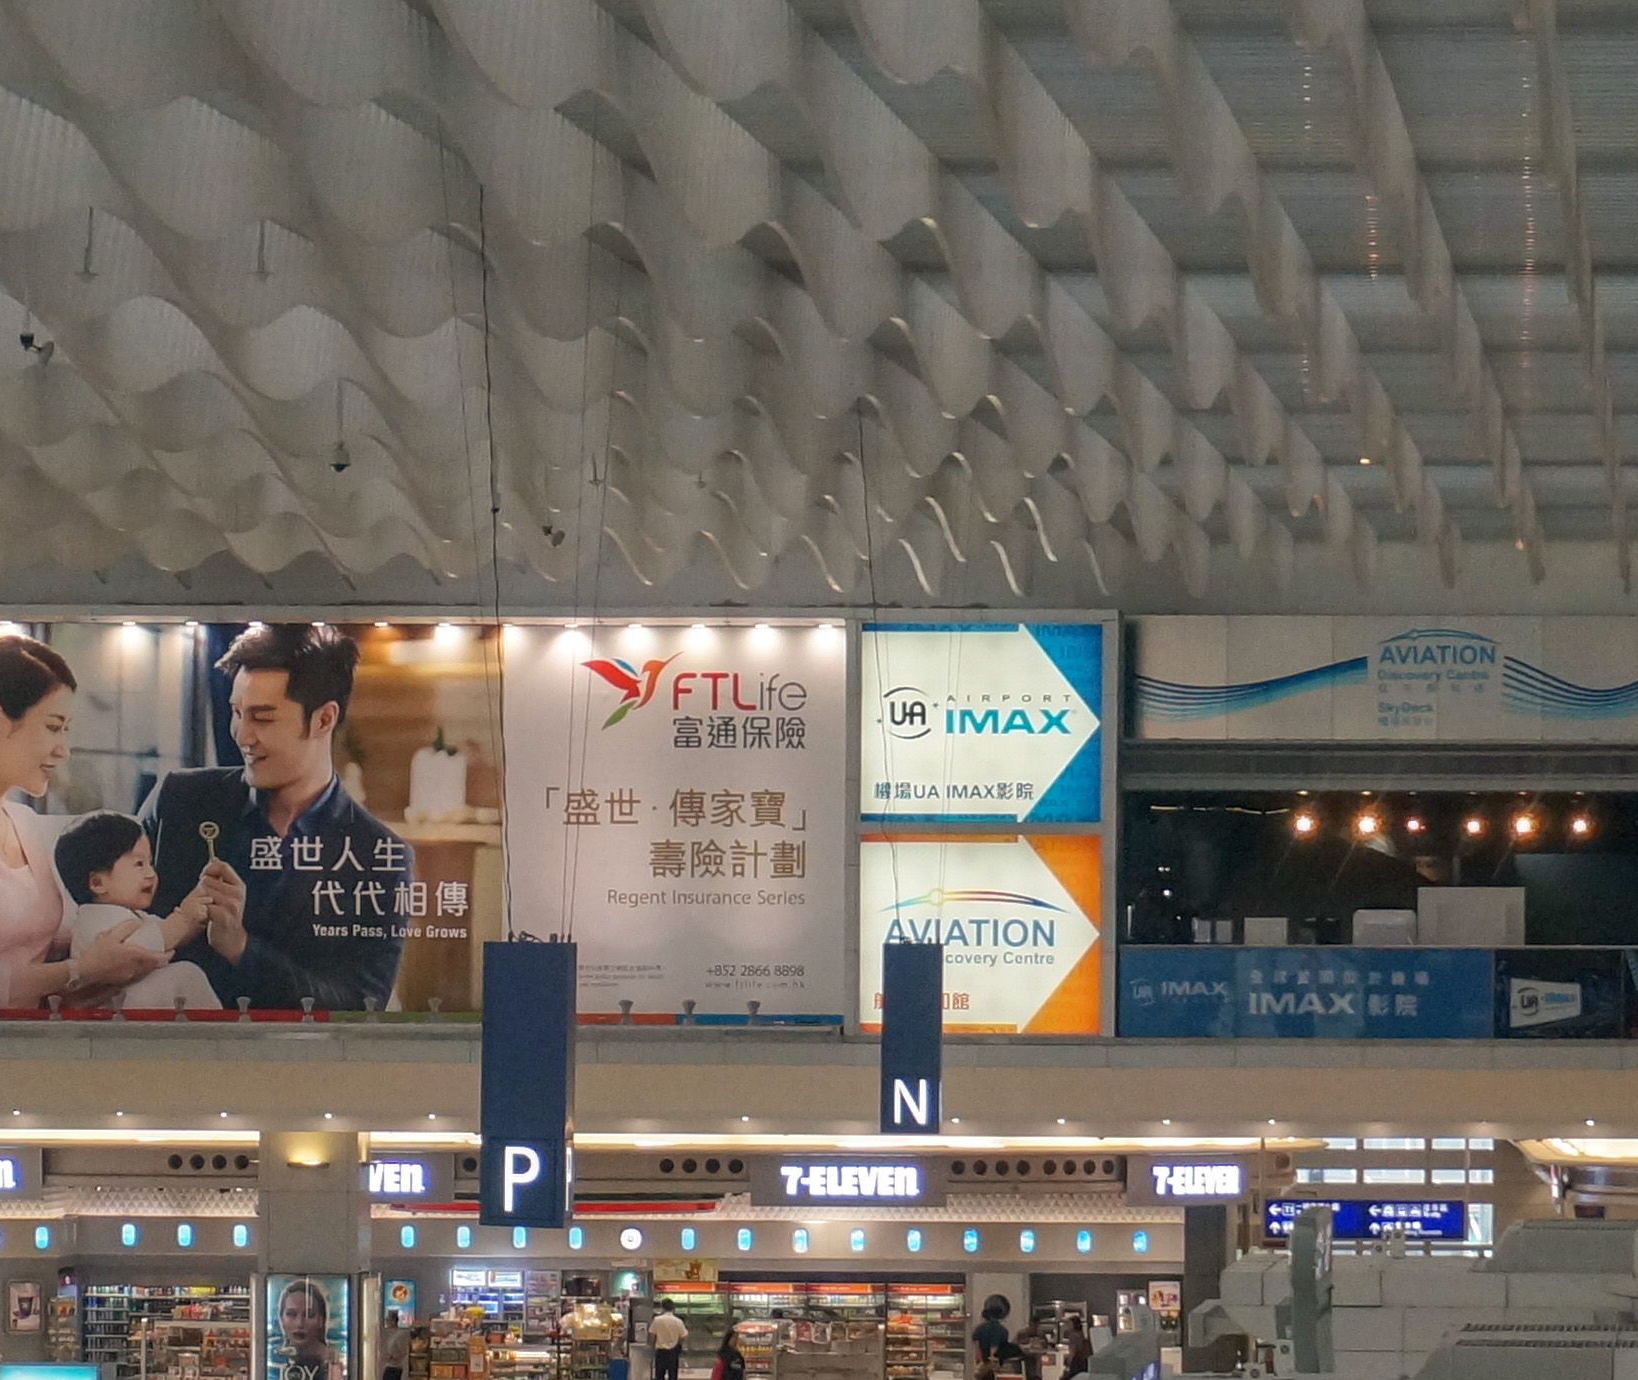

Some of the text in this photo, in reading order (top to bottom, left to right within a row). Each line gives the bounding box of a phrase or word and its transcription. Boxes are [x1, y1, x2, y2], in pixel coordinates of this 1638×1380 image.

[1379, 645, 1496, 665] AVIATION
[672, 673, 807, 711] FTLife
[947, 694, 1071, 703] AIRPORT
[889, 700, 926, 726] UA
[946, 709, 1071, 734] IMAX
[672, 716, 806, 749] 富通保險
[250, 835, 406, 871] 盛世人生
[650, 839, 805, 879] 壽險計劃
[312, 880, 469, 917] 代代相傳
[608, 889, 806, 907] Regent Insurance Series
[313, 924, 467, 939] Years Pass, Love Grows
[885, 919, 1055, 947] AVIATION
[707, 965, 736, 977] +852
[740, 965, 770, 977] 2866
[946, 952, 1055, 967] covery Centre
[1163, 982, 1226, 996] IMAX
[1249, 993, 1355, 1014] IMAX
[894, 1079, 927, 1125] N
[504, 1146, 540, 1212] P
